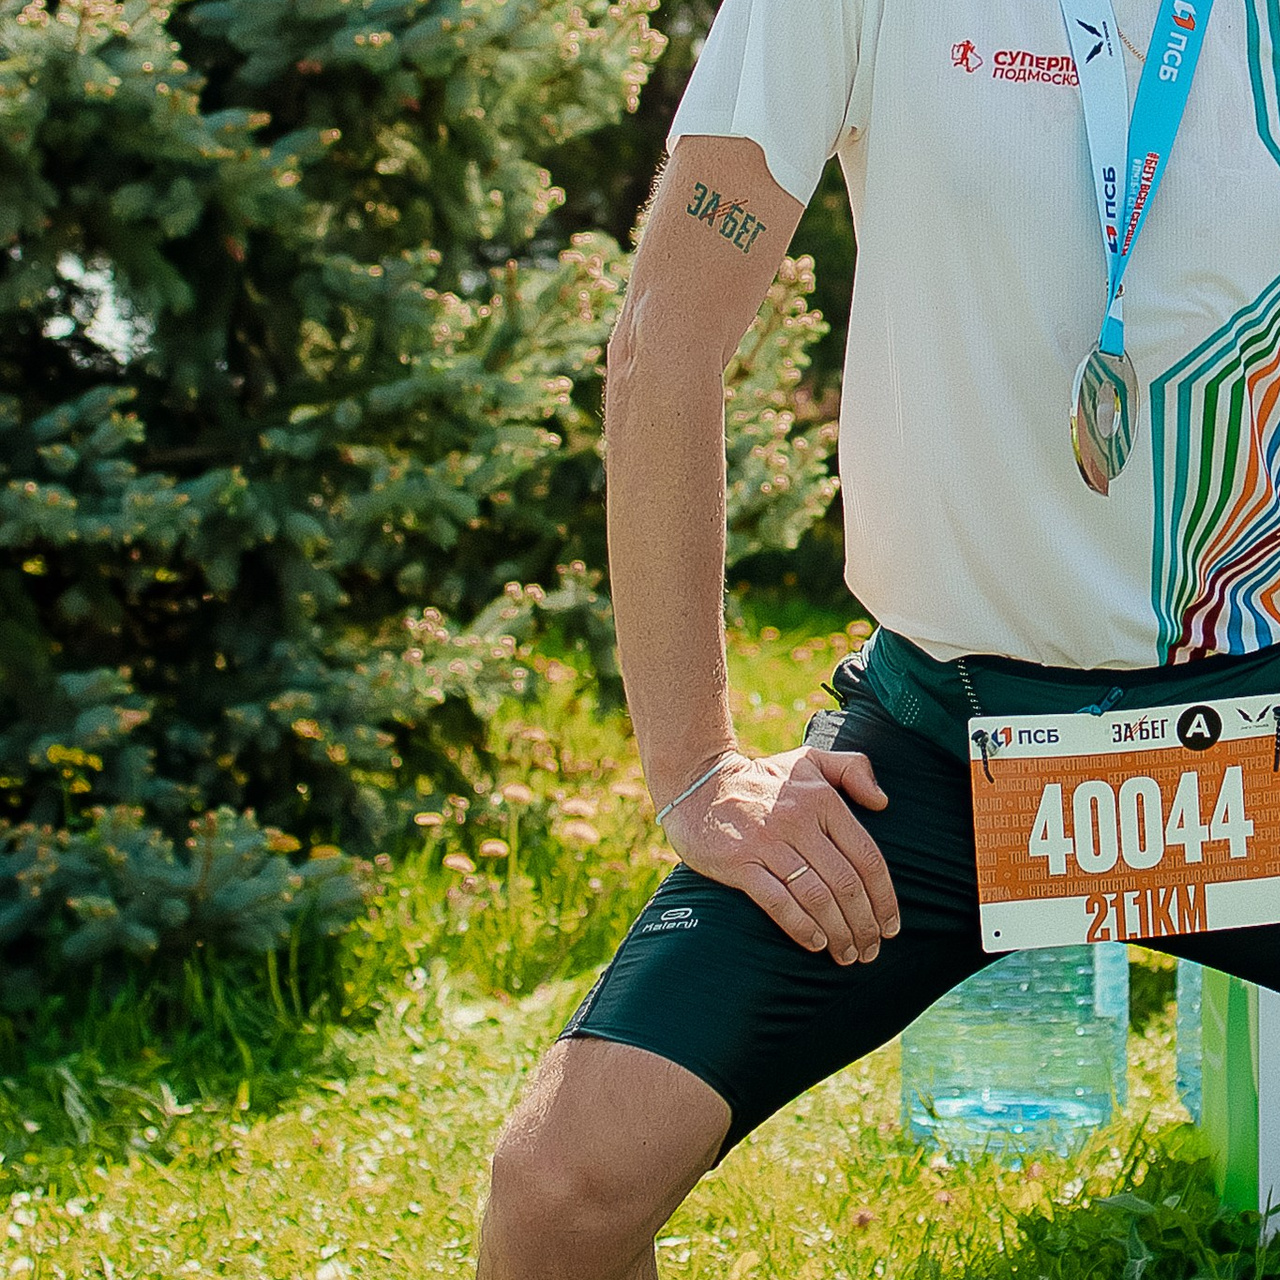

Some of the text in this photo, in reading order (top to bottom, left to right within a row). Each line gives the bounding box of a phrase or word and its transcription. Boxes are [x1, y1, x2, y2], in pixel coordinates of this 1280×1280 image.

[1159, 31, 1188, 83] ПСБ
[1103, 166, 1117, 219] ПСБ
[1018, 728, 1060, 745] ПСБ
[1028, 765, 1254, 876] 40044
